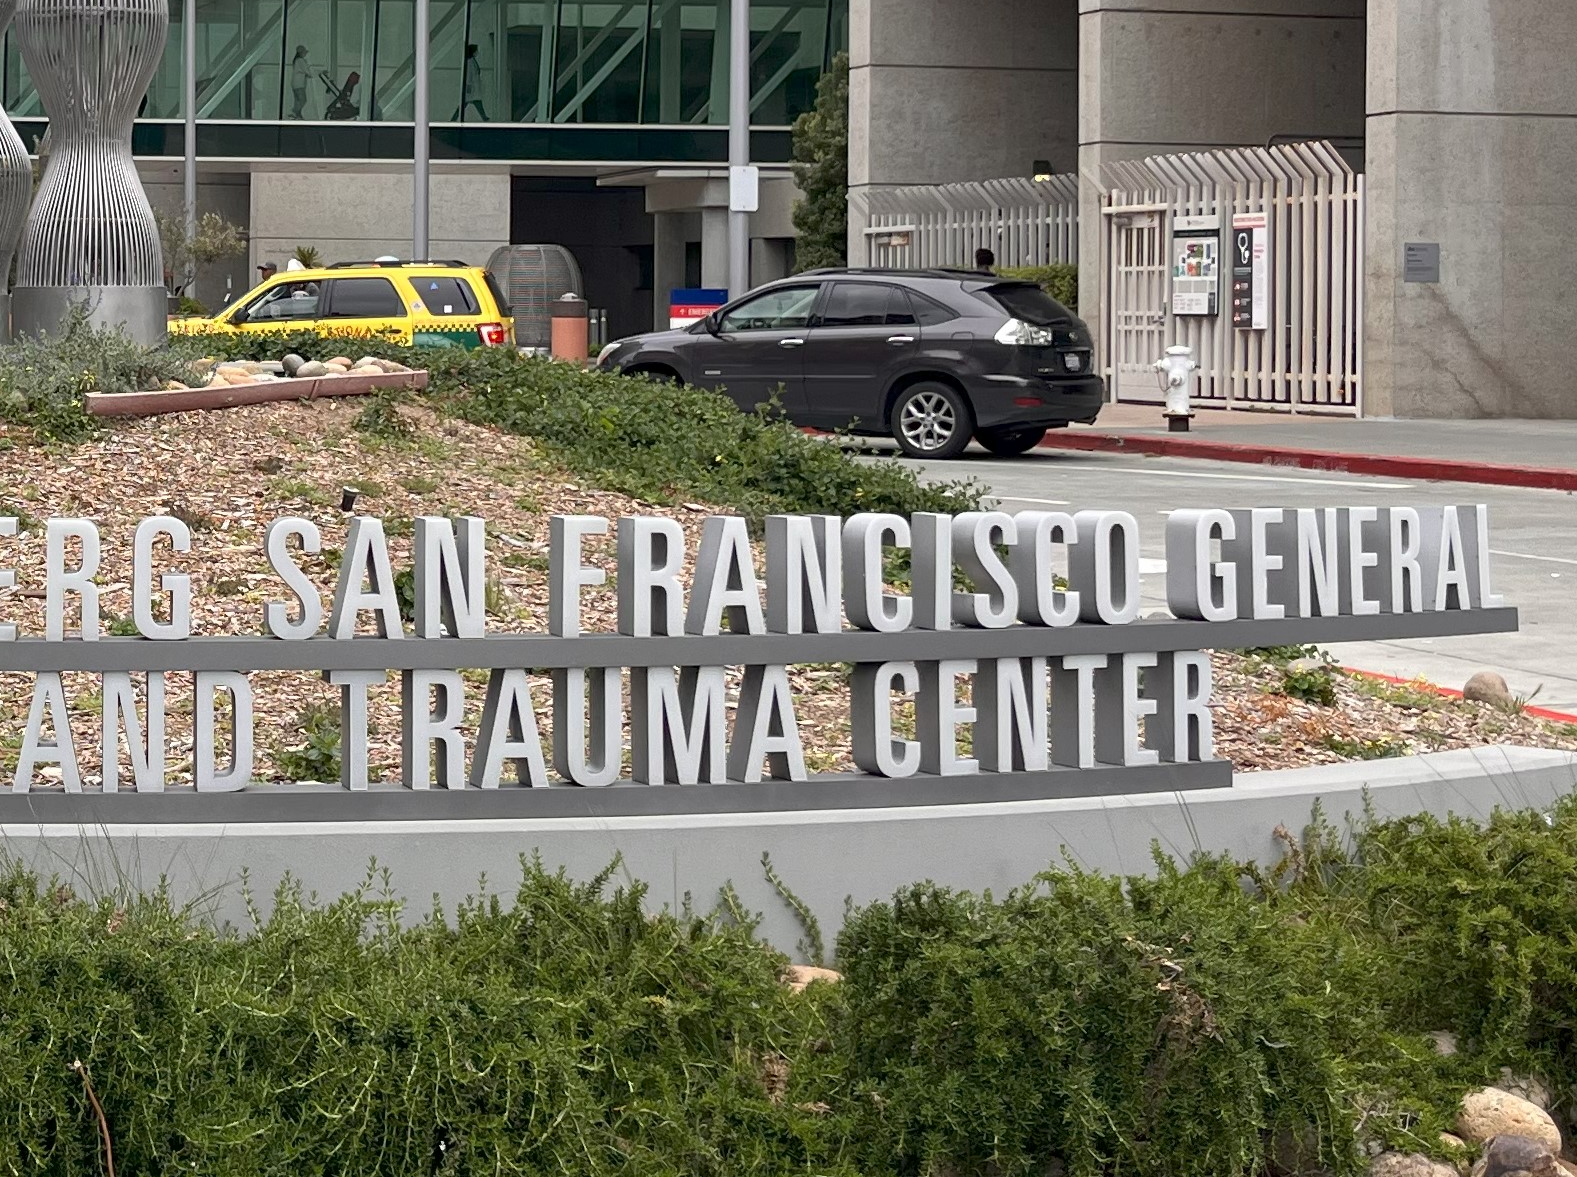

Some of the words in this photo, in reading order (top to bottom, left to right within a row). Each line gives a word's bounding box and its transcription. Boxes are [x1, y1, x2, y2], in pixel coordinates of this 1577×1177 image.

[264, 515, 485, 640] SAN
[549, 510, 1140, 638] FRANCISCO
[1166, 504, 1504, 622] GENERAL
[12, 670, 254, 793] AND
[327, 664, 808, 790] TRAUMA
[851, 650, 1213, 779] CENTER
